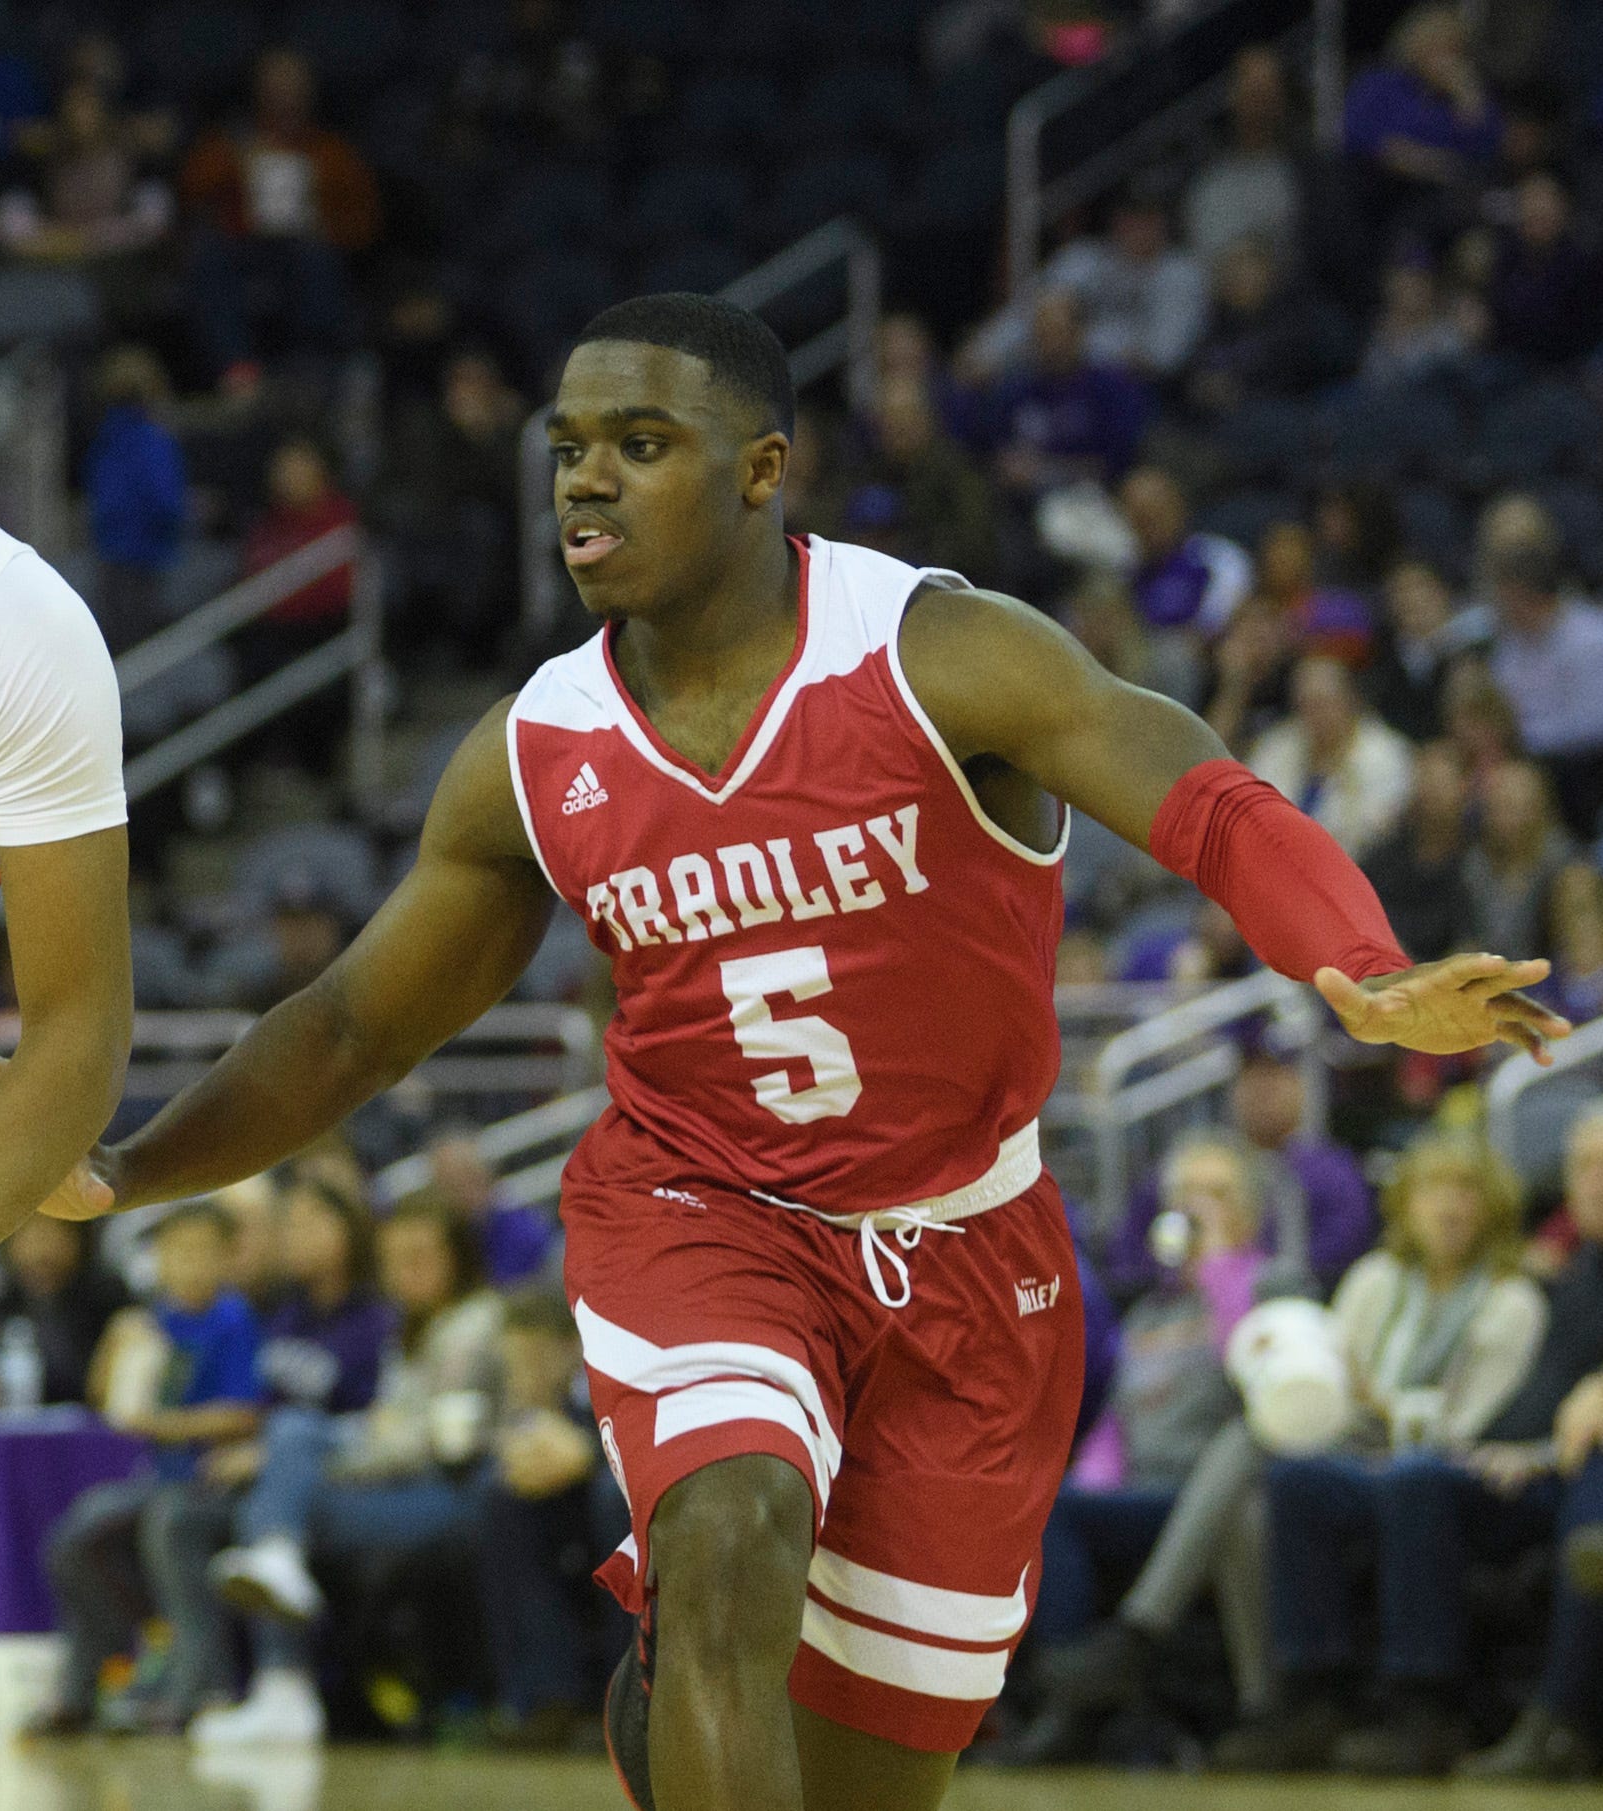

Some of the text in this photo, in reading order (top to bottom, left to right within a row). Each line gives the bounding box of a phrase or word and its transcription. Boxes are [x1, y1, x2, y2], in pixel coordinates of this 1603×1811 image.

[561, 788, 609, 815] adidas
[586, 803, 930, 952] BRADLEY
[719, 945, 863, 1125] 5
